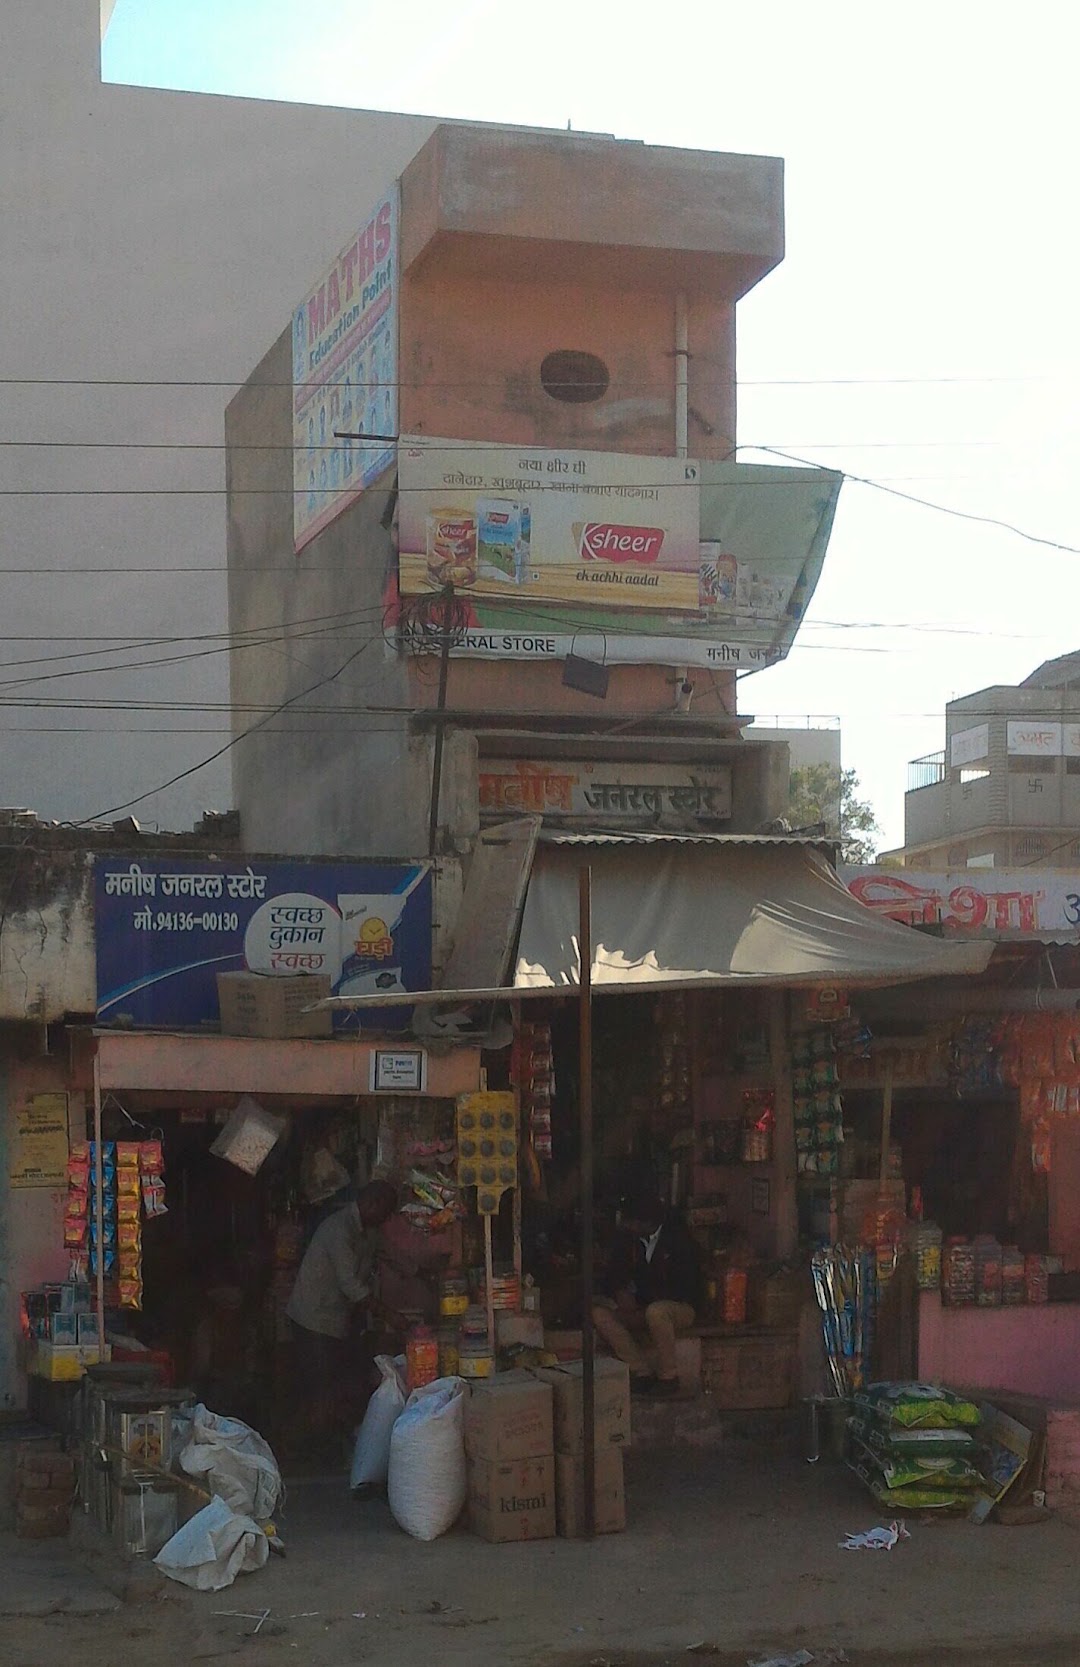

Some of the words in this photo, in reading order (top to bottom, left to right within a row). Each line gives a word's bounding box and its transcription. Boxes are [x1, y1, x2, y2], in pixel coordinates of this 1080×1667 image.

[308, 201, 392, 348] MATHS
[309, 304, 360, 371] Education
[362, 257, 392, 310] Point
[518, 459, 542, 472] नया
[547, 460, 570, 474] क्षीर
[572, 461, 586, 475] घी
[442, 471, 487, 487] दानेदार,
[580, 523, 658, 560] Ksheer
[576, 569, 589, 581] ek
[591, 571, 622, 583] achhi
[625, 574, 660, 586] aadat
[502, 637, 556, 653] STORE
[706, 644, 741, 661] मनीष
[105, 863, 157, 897] मनीष
[160, 874, 224, 898] जनरल
[226, 866, 267, 898] स्टोर
[133, 905, 239, 932] मो.94136-00130
[270, 907, 326, 924] स्वच्छ
[269, 927, 326, 950] दुकान
[271, 953, 326, 969] स्वच्छ
[500, 1493, 547, 1513] kismi
